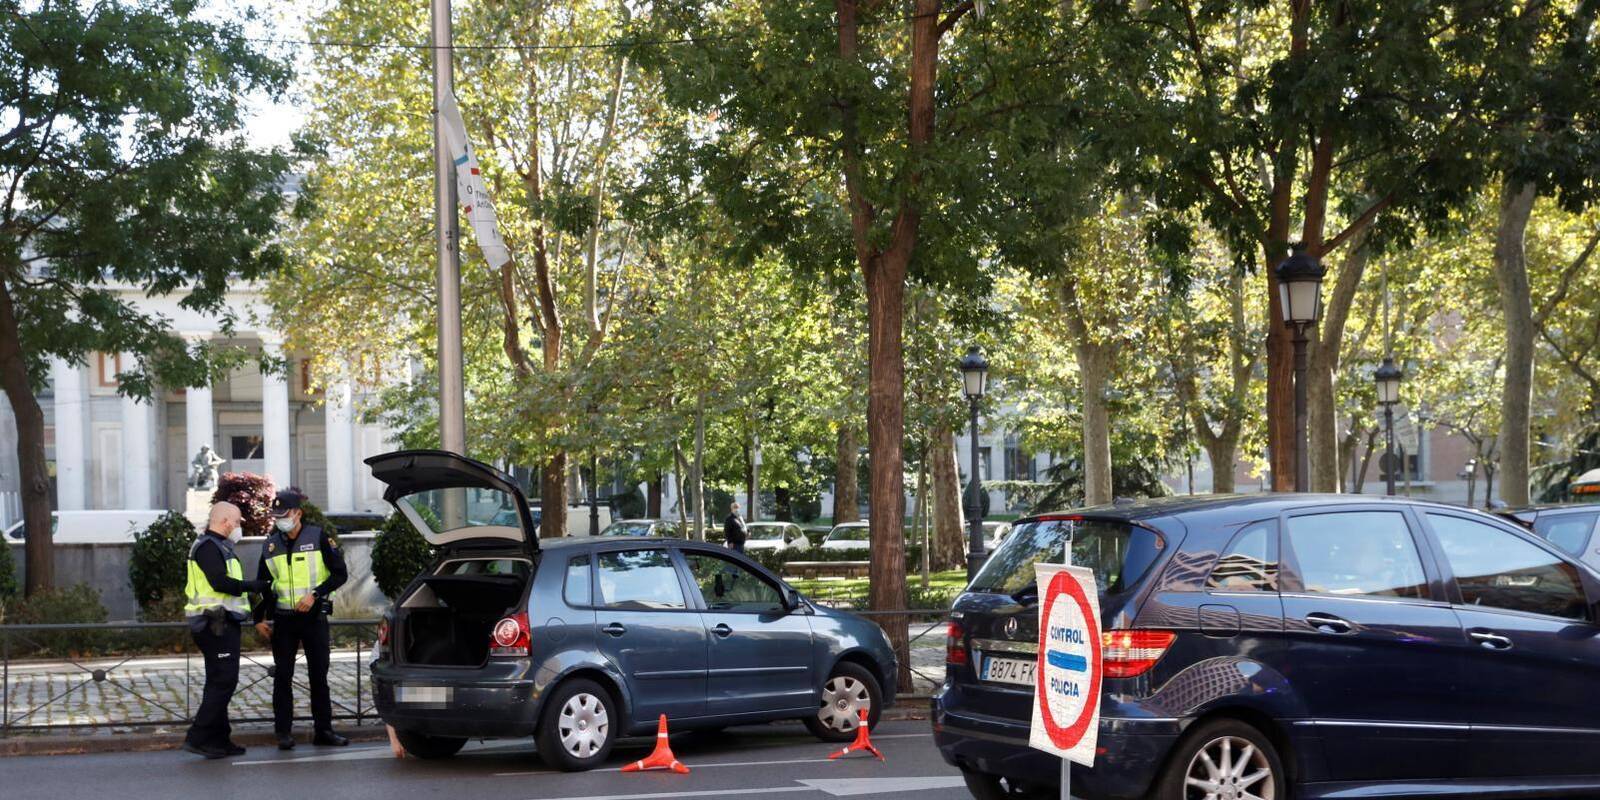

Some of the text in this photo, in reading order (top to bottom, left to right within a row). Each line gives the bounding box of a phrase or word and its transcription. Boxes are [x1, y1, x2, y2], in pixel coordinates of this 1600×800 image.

[1051, 626, 1084, 645] CONTROL
[990, 660, 1036, 683] 8874 FK
